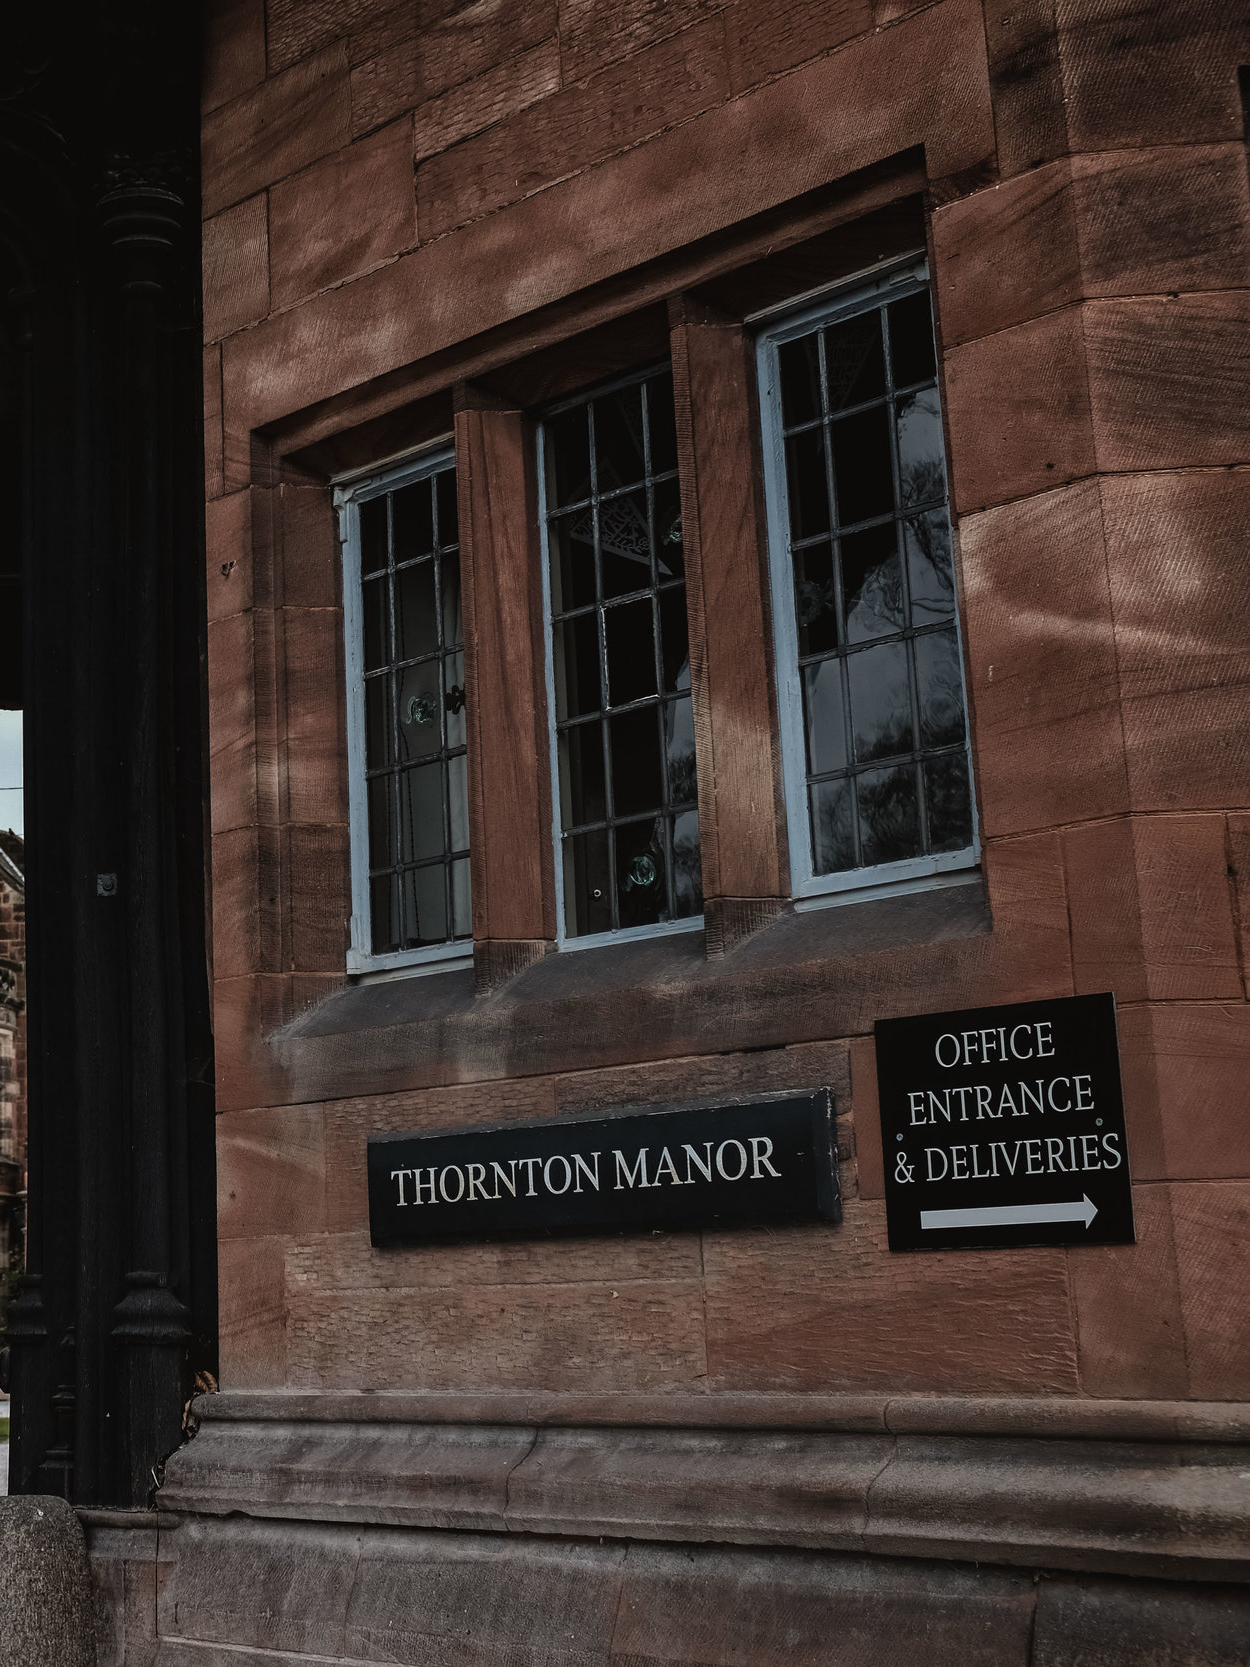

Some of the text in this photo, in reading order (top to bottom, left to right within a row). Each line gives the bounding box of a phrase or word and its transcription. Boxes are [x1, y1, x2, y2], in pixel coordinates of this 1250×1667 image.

[935, 1022, 1055, 1067] OFFICE
[907, 1075, 1095, 1125] ENTRANCE
[391, 1136, 781, 1206] THORNTON MANOR
[894, 1133, 1122, 1183] & DELIVERIES
